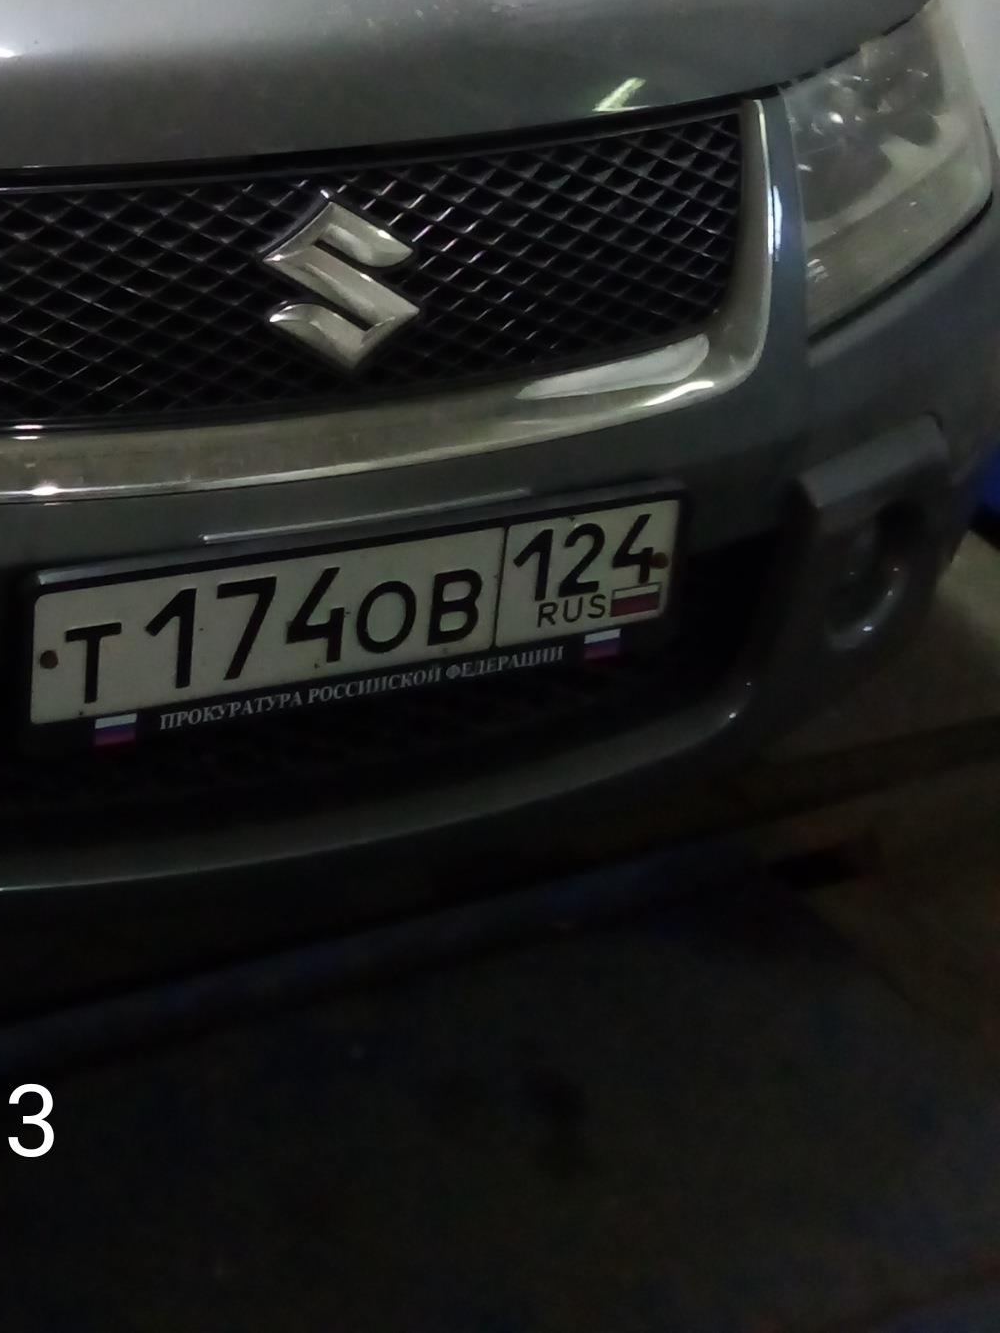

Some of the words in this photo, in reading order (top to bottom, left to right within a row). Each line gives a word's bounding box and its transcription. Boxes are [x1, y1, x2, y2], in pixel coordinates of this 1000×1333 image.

[512, 514, 652, 603] 124
[536, 593, 606, 628] RUS
[159, 690, 301, 731] ПРОКУРАТУРА
[446, 645, 564, 681] ФЕДЕРАЦИИ
